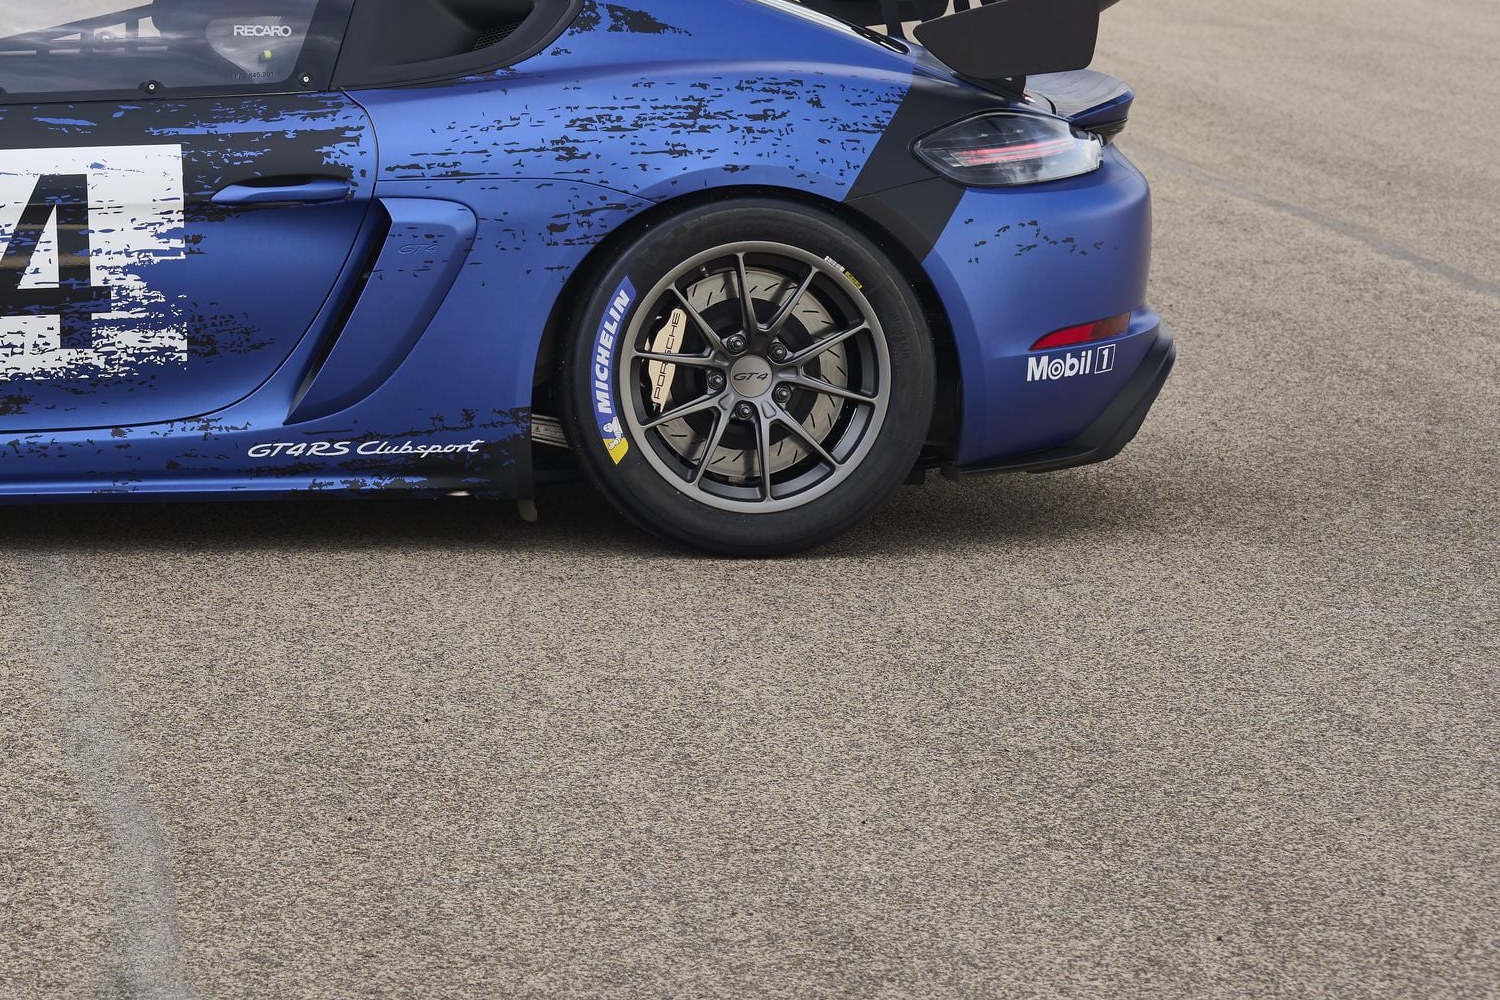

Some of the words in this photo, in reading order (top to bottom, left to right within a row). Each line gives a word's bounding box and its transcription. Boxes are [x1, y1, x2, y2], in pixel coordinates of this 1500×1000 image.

[233, 25, 292, 37] RECARO
[595, 289, 631, 414] MICHELIN
[1026, 349, 1092, 382] Mobil
[733, 371, 768, 381] GT4
[357, 440, 485, 459] Clubsport
